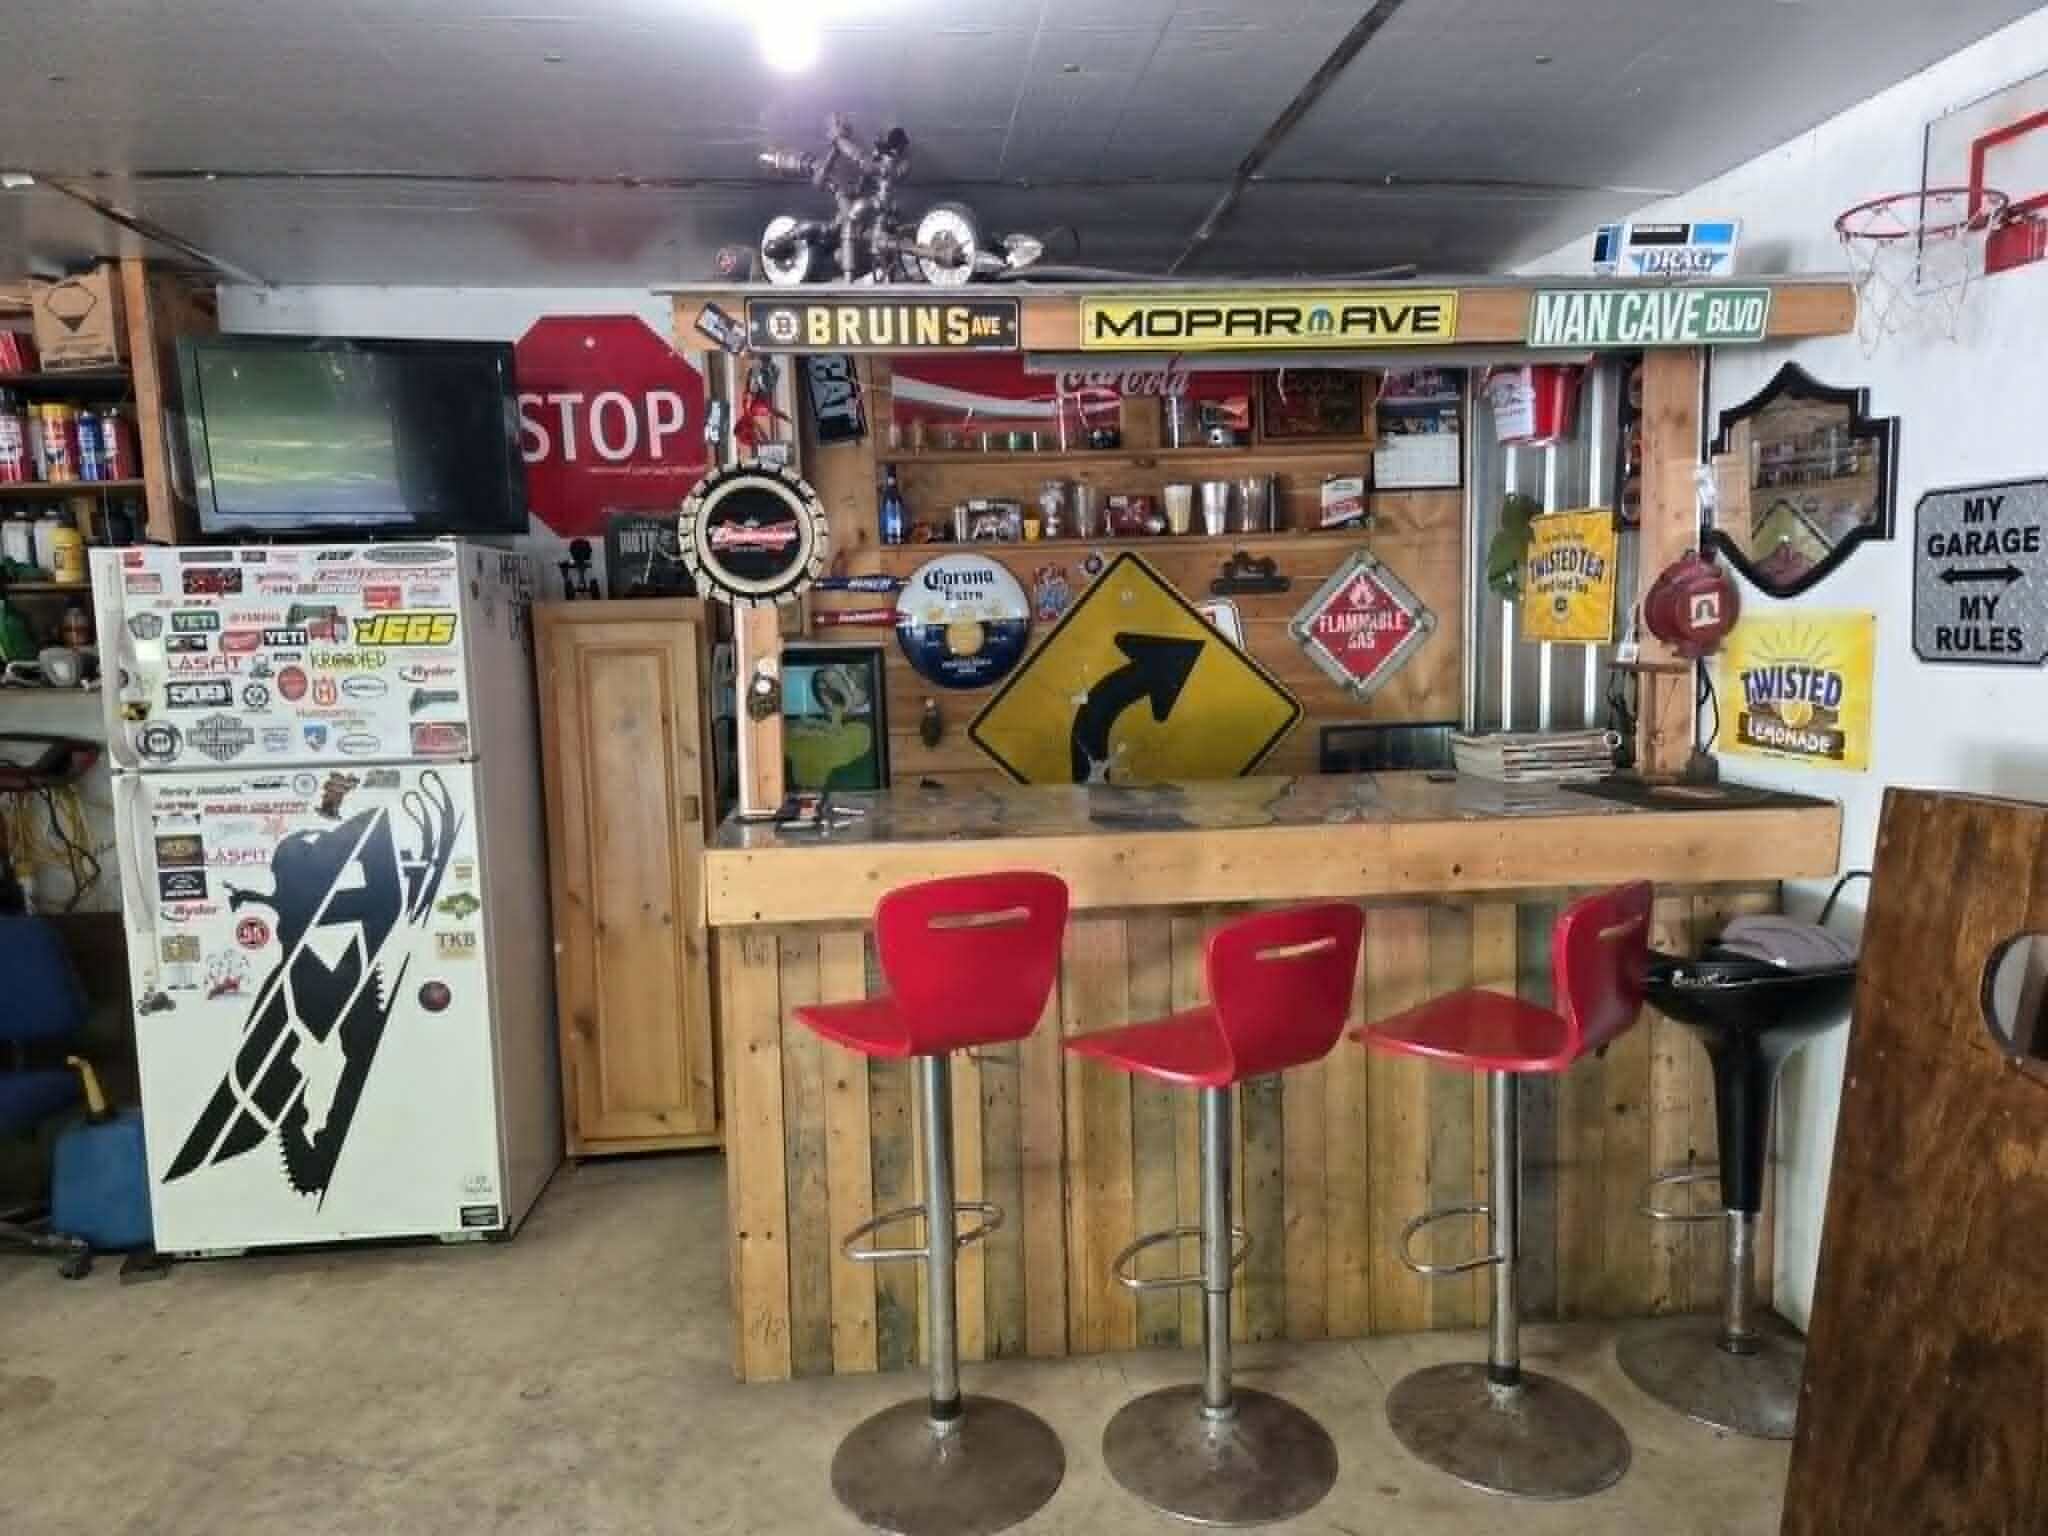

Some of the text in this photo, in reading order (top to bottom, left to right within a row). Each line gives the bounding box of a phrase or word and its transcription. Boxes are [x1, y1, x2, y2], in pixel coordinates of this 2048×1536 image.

[807, 306, 1001, 345] BRUINS AVE
[1095, 308, 1302, 339] MOPAR
[1341, 304, 1441, 334] AVE
[1534, 291, 1763, 342] MAN CAVE BLVD
[517, 391, 685, 463] STOP
[1963, 495, 2006, 523] MY
[1928, 527, 2041, 558] GARAGE
[923, 566, 994, 591] Corona
[174, 613, 217, 631] YETI
[1959, 595, 2000, 621] MY
[265, 630, 306, 644] YETI
[358, 613, 456, 645] JEGS
[1936, 625, 2025, 652] RULES
[167, 655, 242, 671] LASFIT
[1740, 664, 1843, 706] TWISTED
[1747, 716, 1835, 753] LEMONADE
[435, 931, 477, 948] TKB
